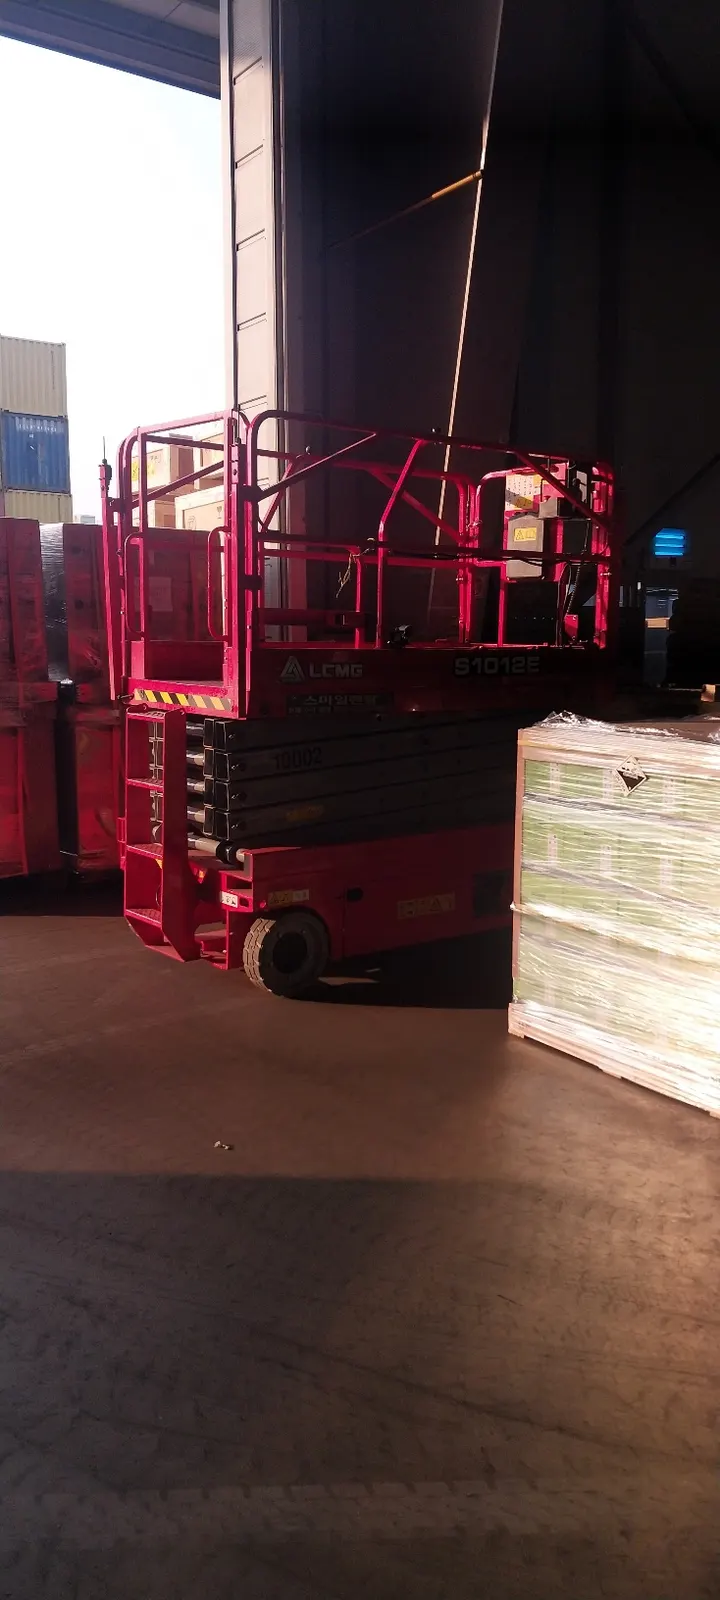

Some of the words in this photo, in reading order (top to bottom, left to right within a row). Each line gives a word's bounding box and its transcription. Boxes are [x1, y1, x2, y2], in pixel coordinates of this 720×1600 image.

[309, 662, 363, 679] LCMG
[454, 656, 541, 676] S1012E
[273, 747, 323, 769] 10002
